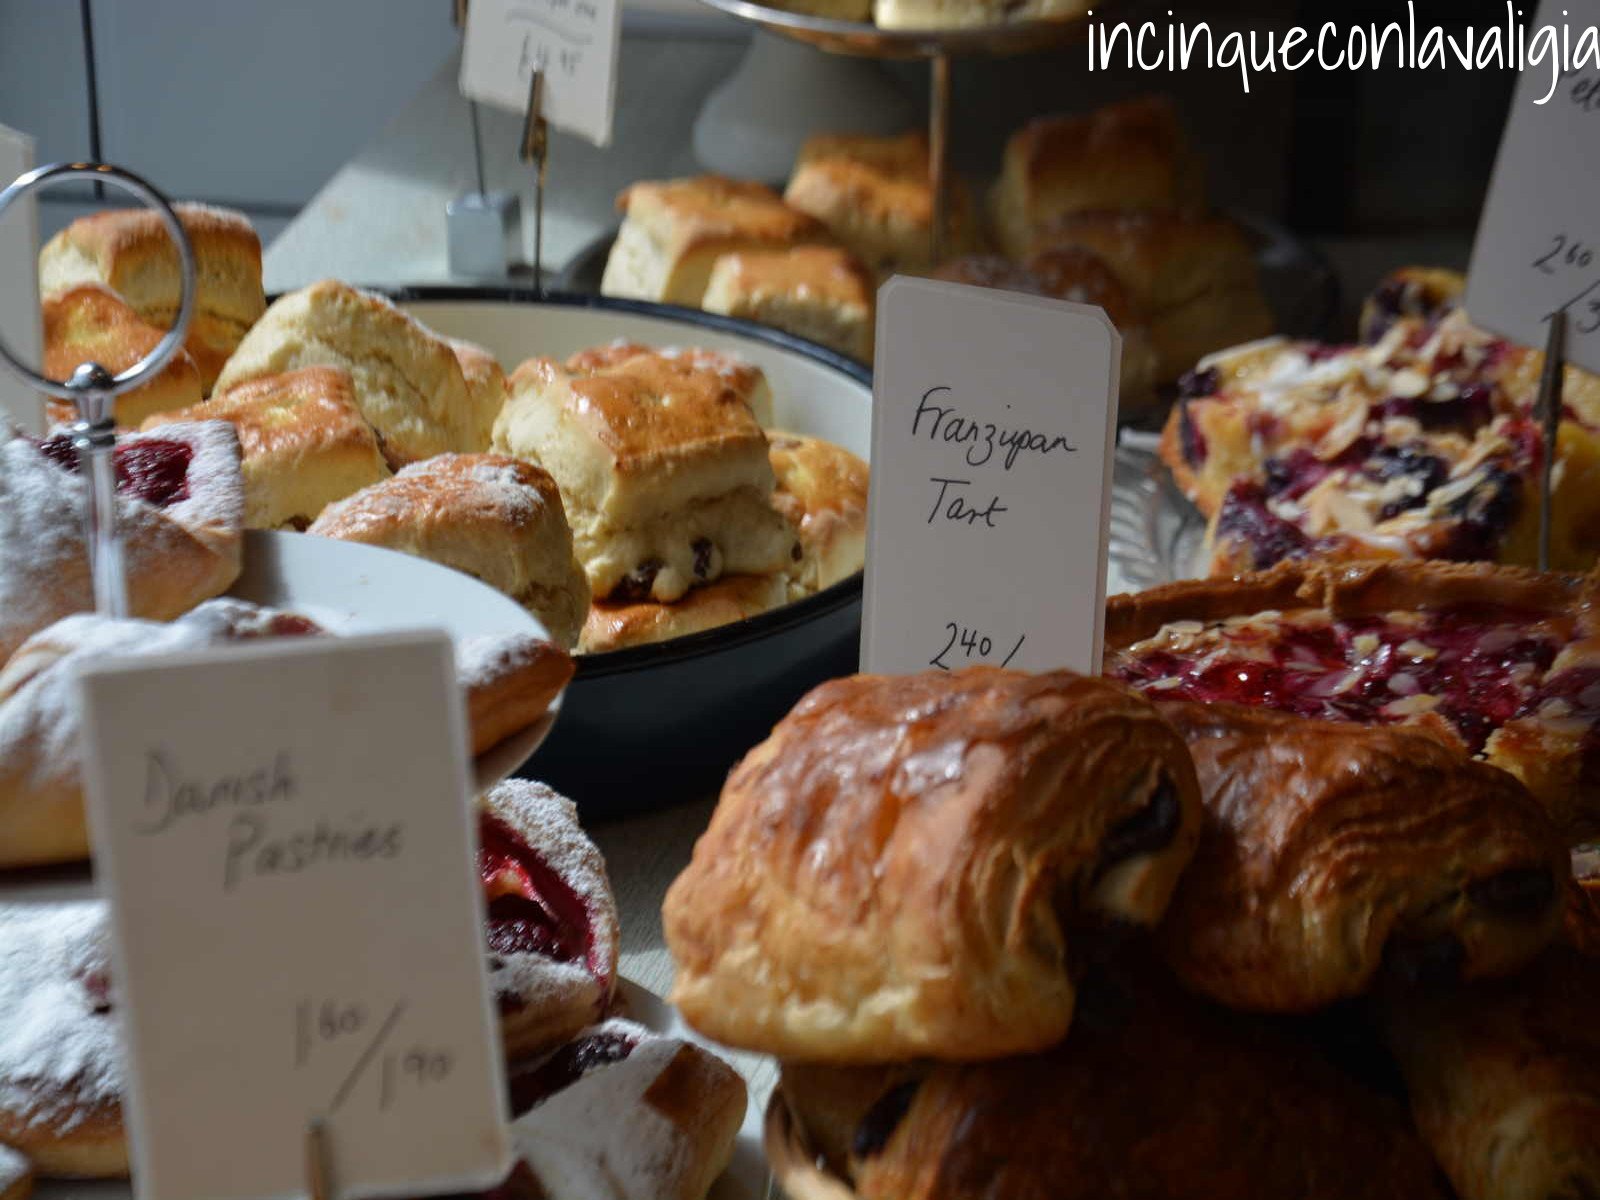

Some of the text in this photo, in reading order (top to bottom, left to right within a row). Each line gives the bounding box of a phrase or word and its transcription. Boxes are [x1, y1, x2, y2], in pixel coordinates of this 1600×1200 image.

[927, 477, 1008, 527] Tart
[131, 746, 299, 836] Danish
[223, 811, 405, 893] Pastries
